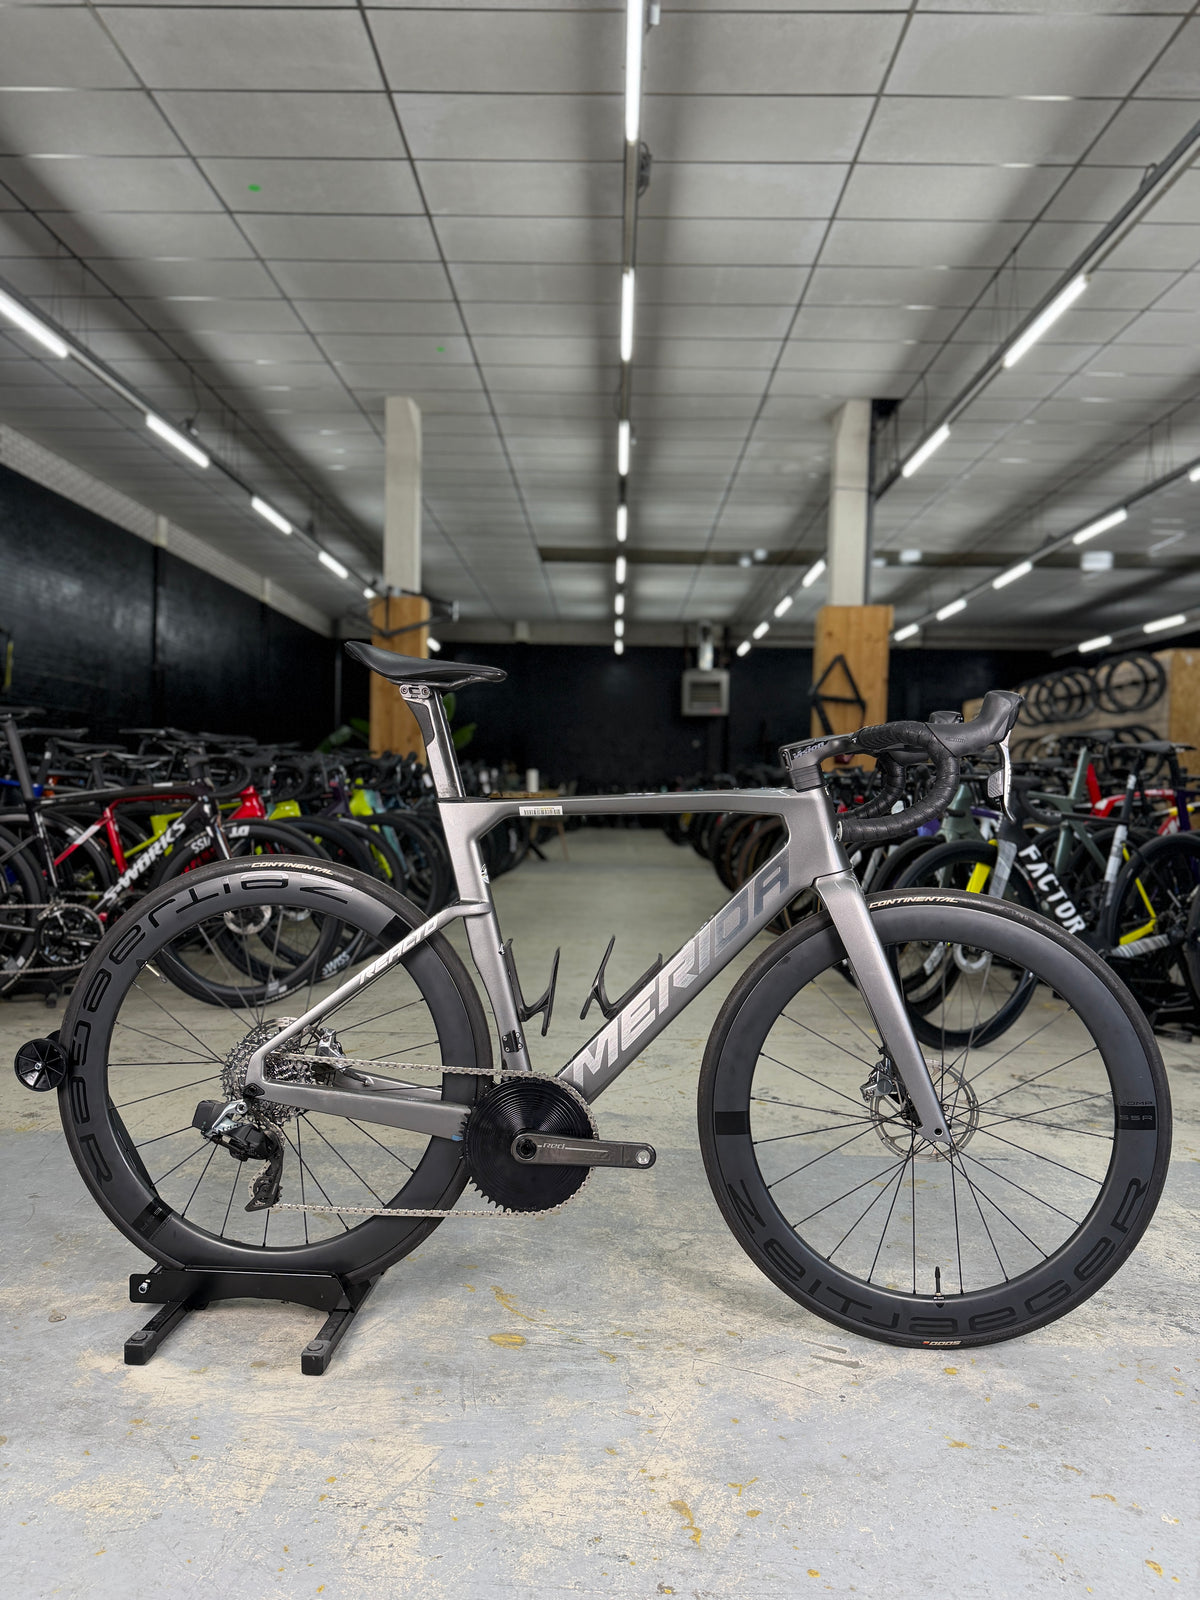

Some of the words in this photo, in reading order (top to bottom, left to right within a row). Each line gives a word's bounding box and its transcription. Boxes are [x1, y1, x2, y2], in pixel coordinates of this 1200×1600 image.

[103, 822, 187, 907] S-WORKS
[229, 825, 250, 838] DT
[251, 861, 334, 876] CONTINENTAL
[868, 896, 960, 909] CONTINENTAL
[1018, 843, 1087, 935] FACTOR
[359, 916, 438, 985] REACTO
[572, 848, 791, 1088] MERIDA
